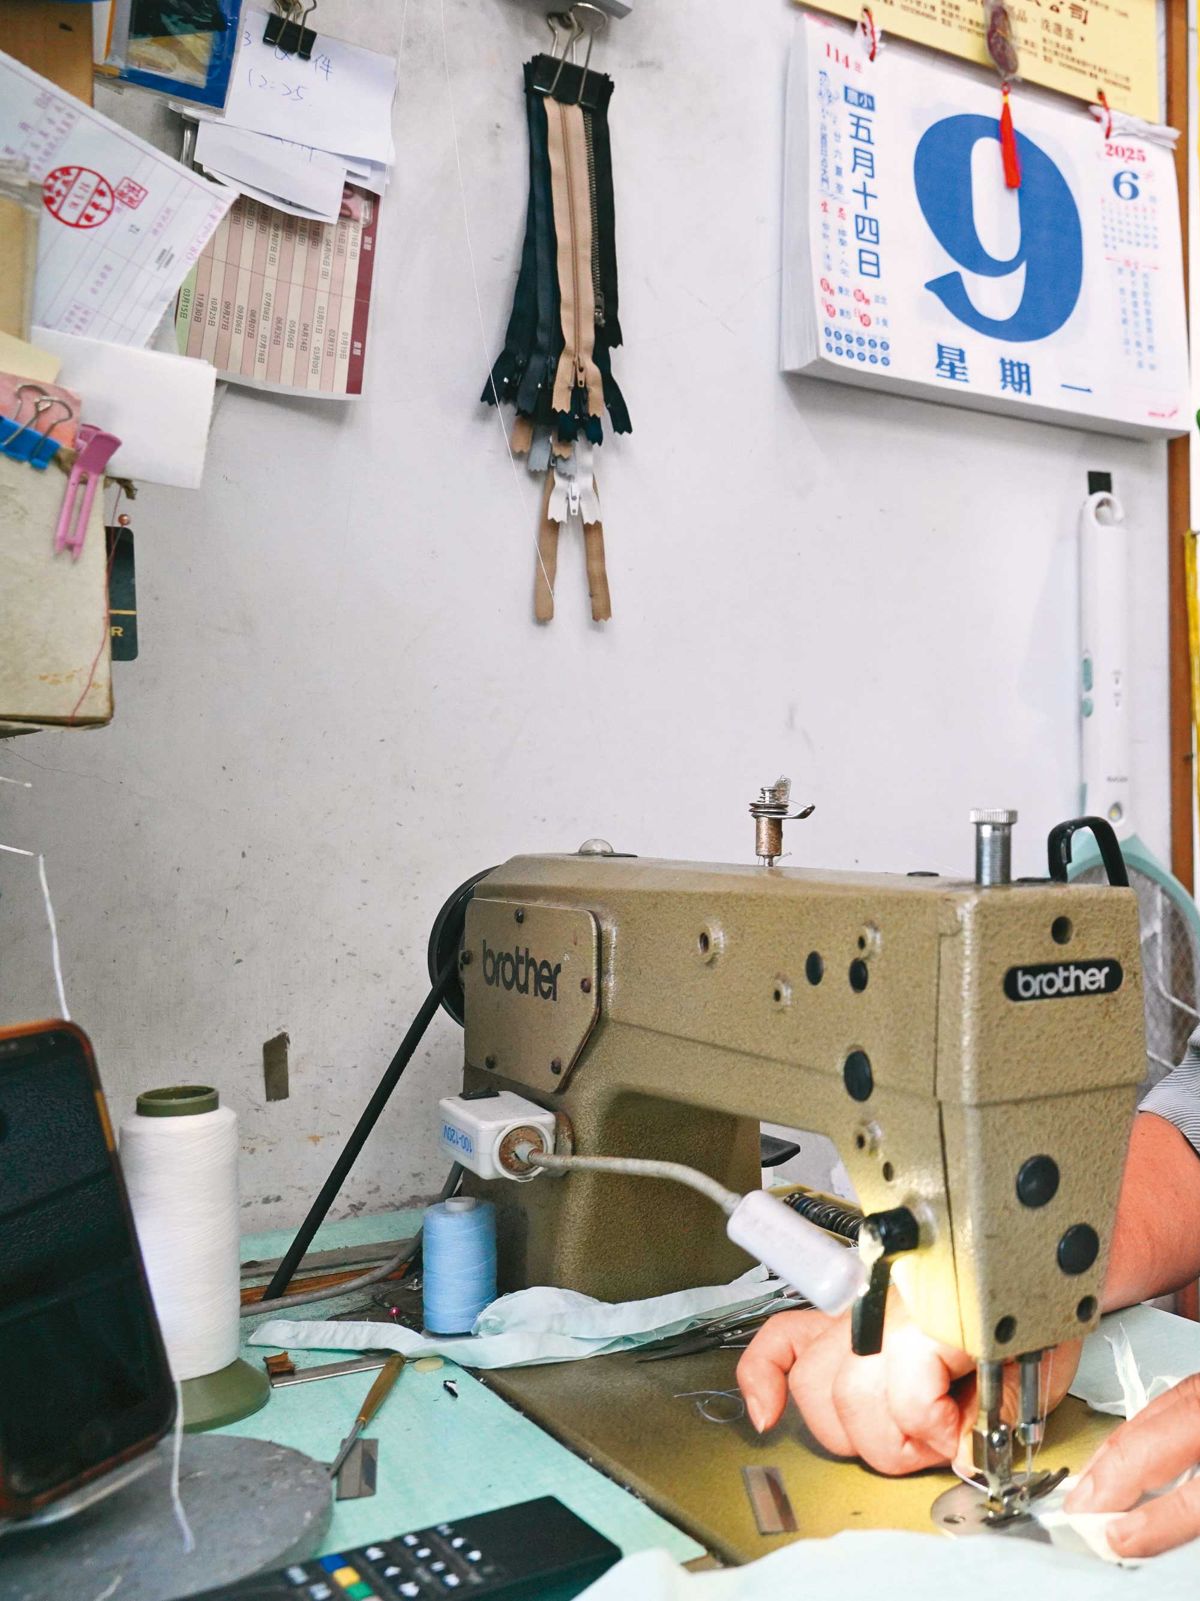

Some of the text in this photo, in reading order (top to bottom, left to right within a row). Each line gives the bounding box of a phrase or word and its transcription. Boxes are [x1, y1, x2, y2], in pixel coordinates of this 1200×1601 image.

[1104, 143, 1147, 163] 2025
[847, 112, 881, 280] 五月十四日
[1112, 170, 1140, 201] 6
[913, 113, 1084, 343] 9
[934, 342, 1094, 397] 星期一
[481, 939, 562, 1001] brother
[1016, 964, 1112, 998] brother
